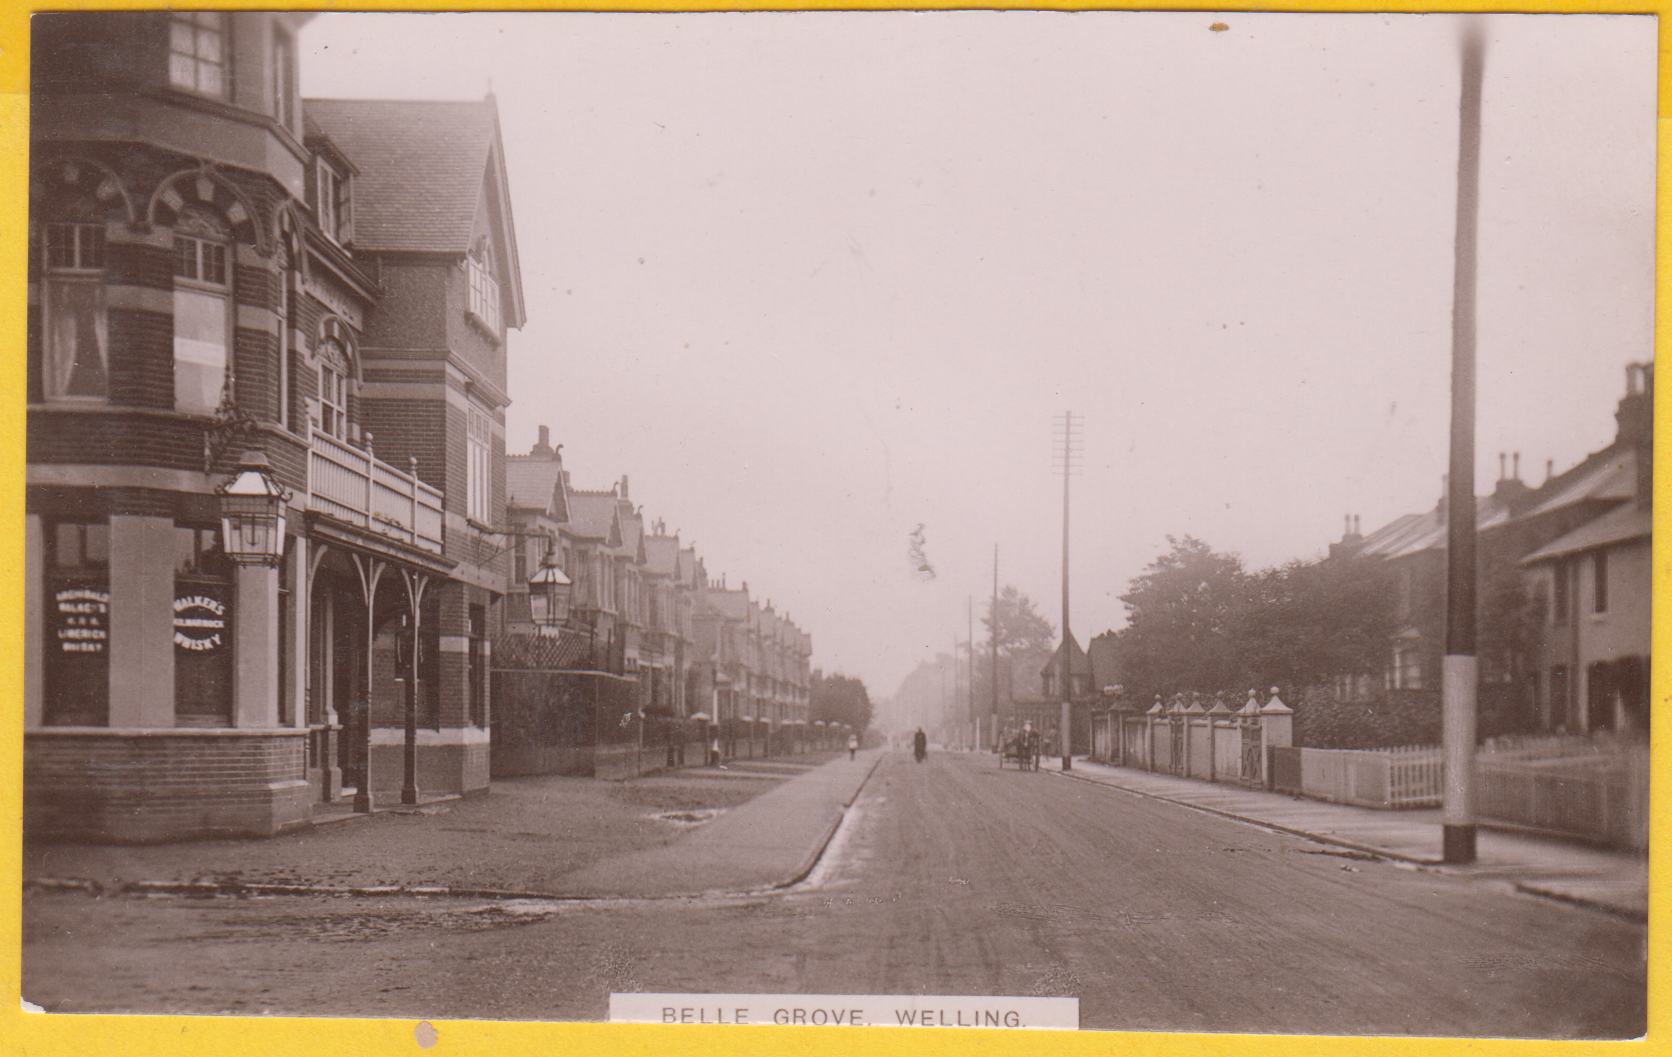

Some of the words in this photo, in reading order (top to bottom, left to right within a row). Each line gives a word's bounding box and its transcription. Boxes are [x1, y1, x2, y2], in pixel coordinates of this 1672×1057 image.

[173, 596, 225, 615] WALKER'S
[173, 618, 224, 628] KILMARNOCK
[174, 632, 222, 651] WHISKY
